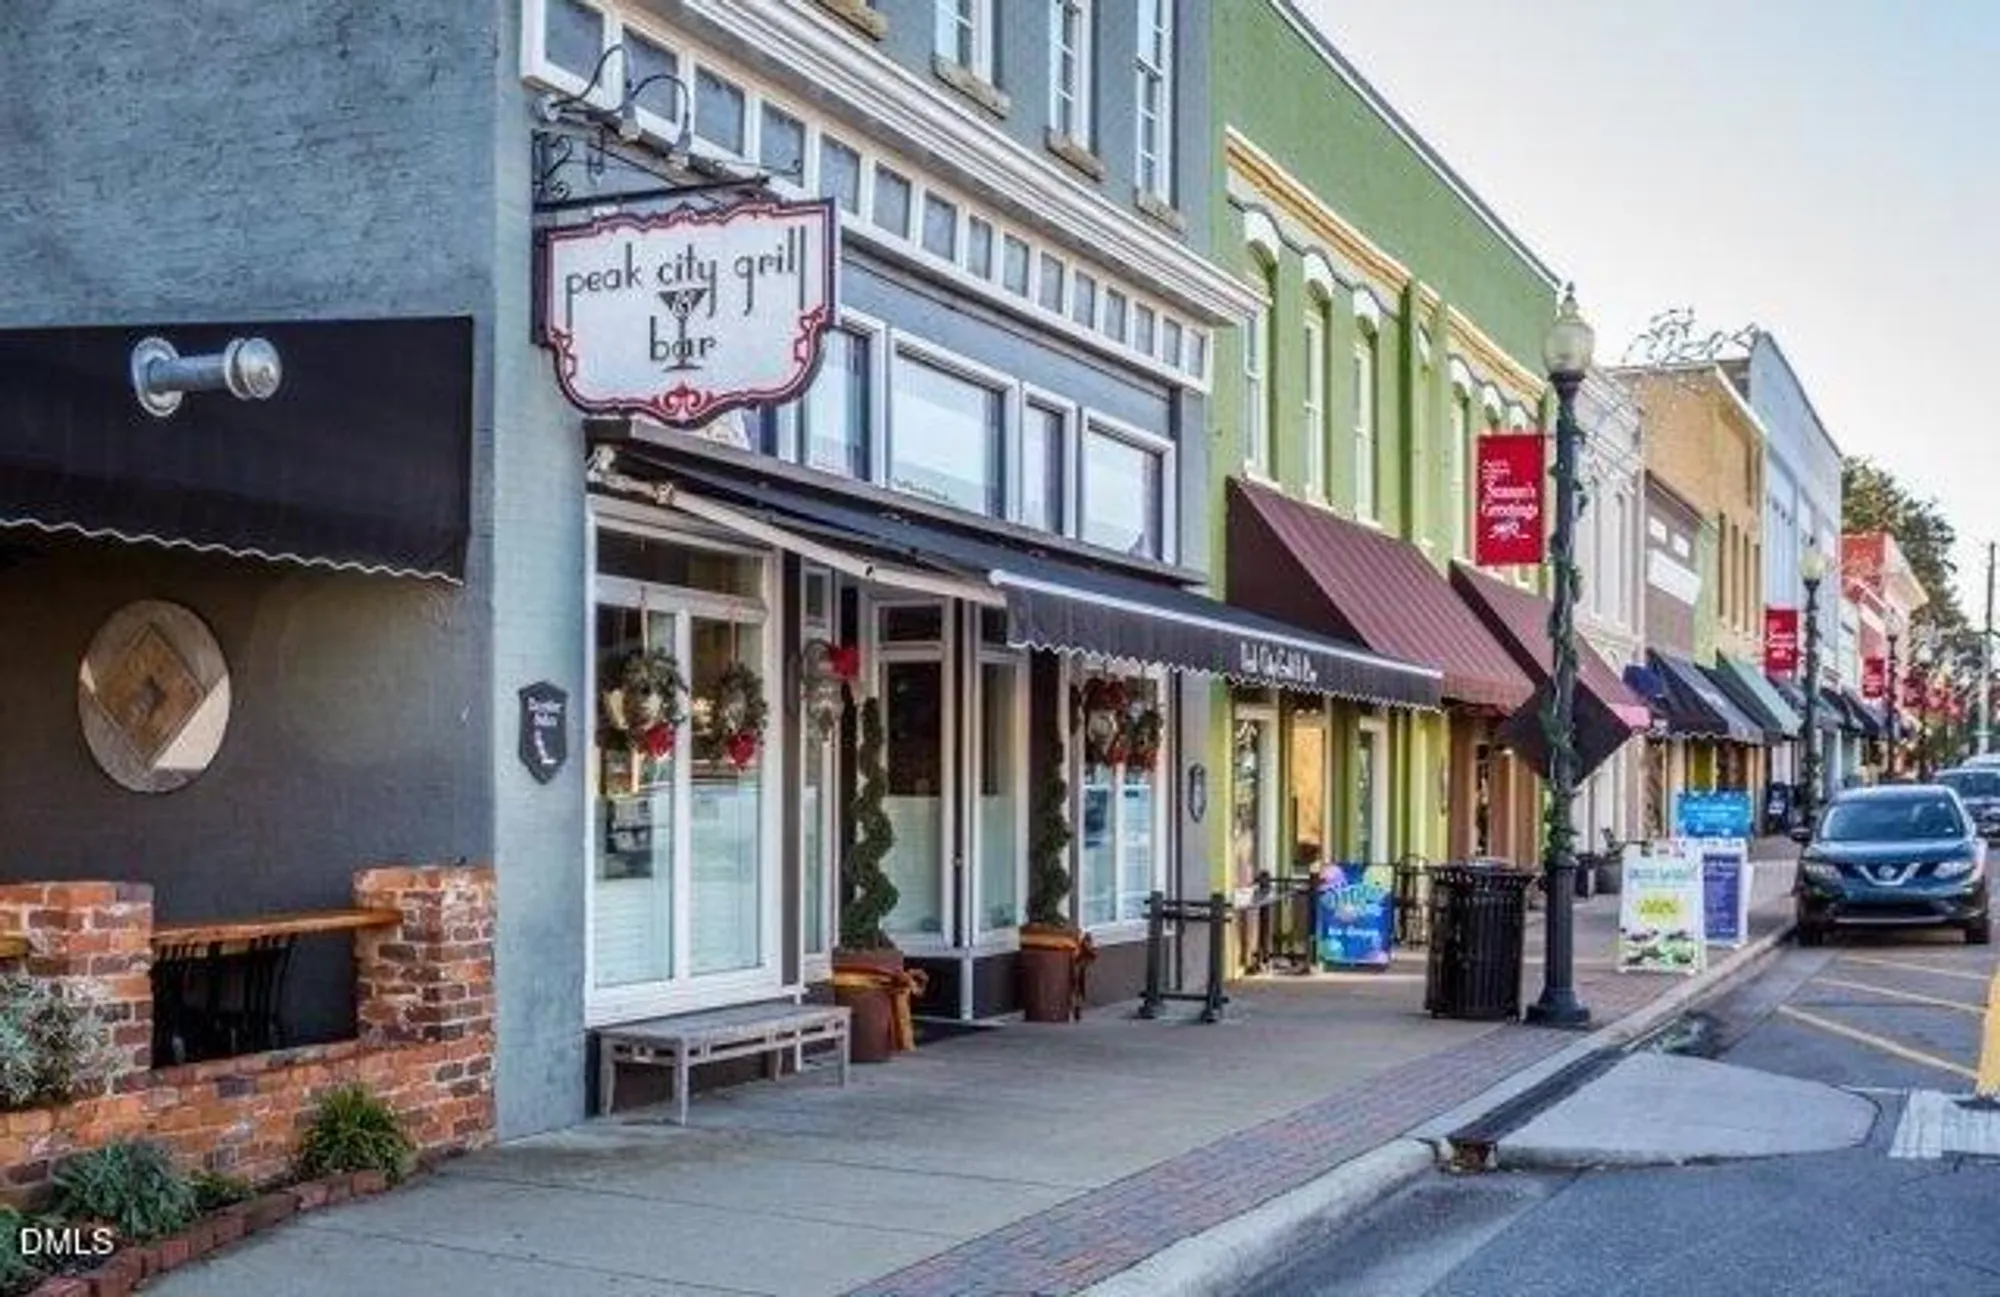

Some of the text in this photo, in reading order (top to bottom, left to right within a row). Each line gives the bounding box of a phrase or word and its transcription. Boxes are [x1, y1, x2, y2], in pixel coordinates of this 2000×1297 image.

[565, 225, 805, 329] peak city grill
[649, 315, 717, 362] bar
